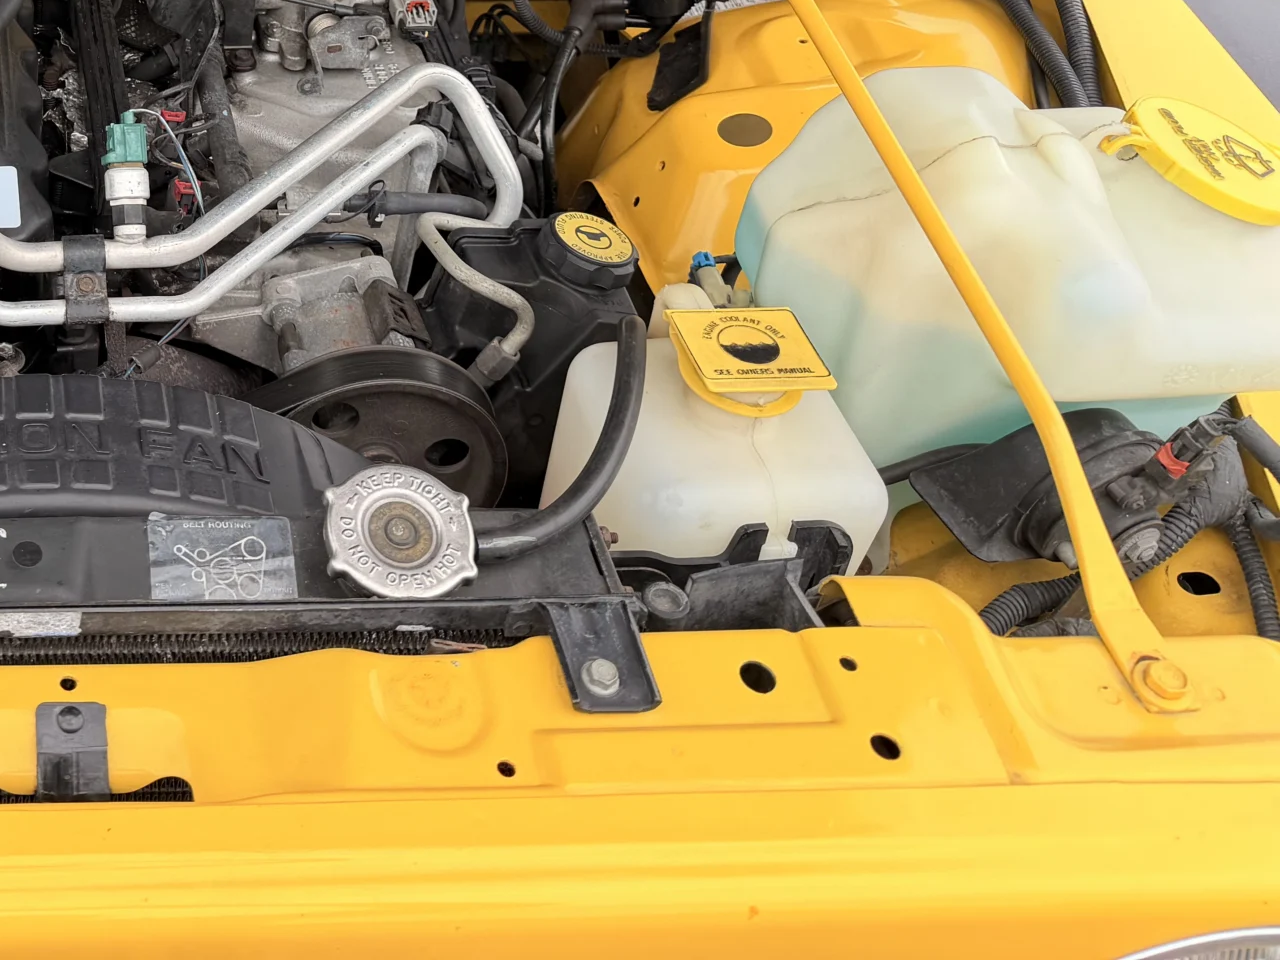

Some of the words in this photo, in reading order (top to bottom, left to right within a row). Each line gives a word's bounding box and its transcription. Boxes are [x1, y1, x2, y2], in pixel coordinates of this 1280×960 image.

[556, 217, 566, 235] FLUID
[564, 213, 605, 226] STEERING
[571, 242, 614, 261] APPROVED
[702, 320, 720, 340] ENGINE
[719, 315, 762, 327] COOLANT
[764, 324, 787, 340] ONLY
[713, 368, 734, 376] SEE
[736, 367, 774, 376] OWNERS
[776, 366, 816, 375] MANUAL
[139, 427, 272, 485] FAN
[355, 472, 405, 497] KEEP
[409, 474, 456, 514] TIGHT
[182, 521, 205, 529] BELT
[207, 521, 253, 529] ROUTING
[340, 516, 357, 540] DO
[347, 544, 381, 575] NOT
[434, 543, 463, 580] HOT
[385, 569, 436, 589] OPEN
